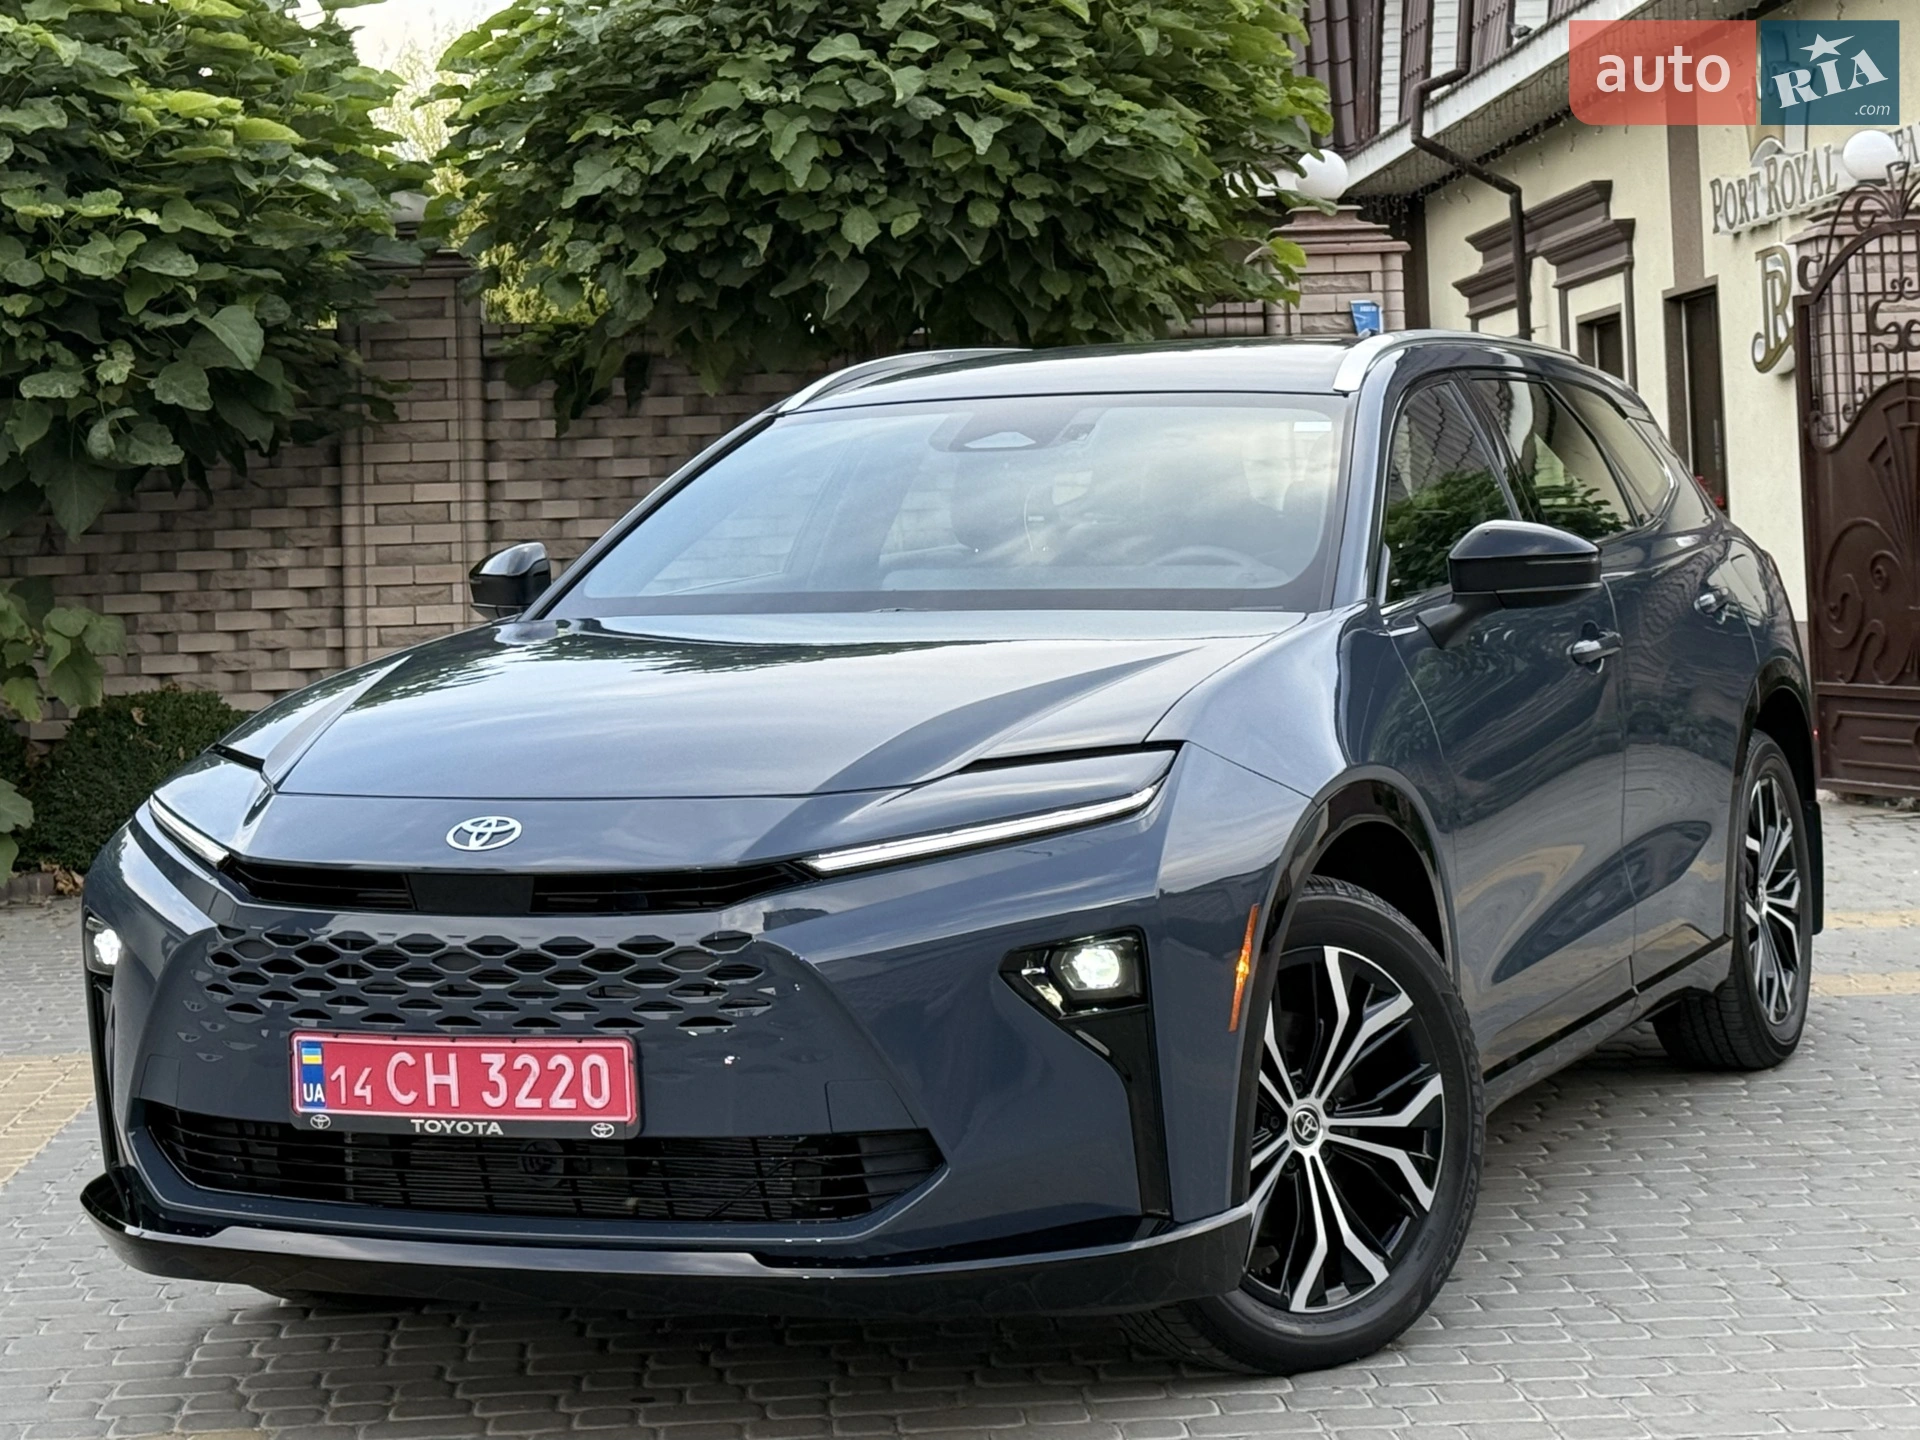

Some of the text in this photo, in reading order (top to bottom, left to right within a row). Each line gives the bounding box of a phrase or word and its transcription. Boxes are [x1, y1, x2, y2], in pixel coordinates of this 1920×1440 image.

[1709, 144, 1839, 235] PORT ROYAL
[302, 1083, 326, 1103] UA
[329, 1051, 611, 1110] 14 CH 3220
[410, 1118, 504, 1137] TOYOTA
